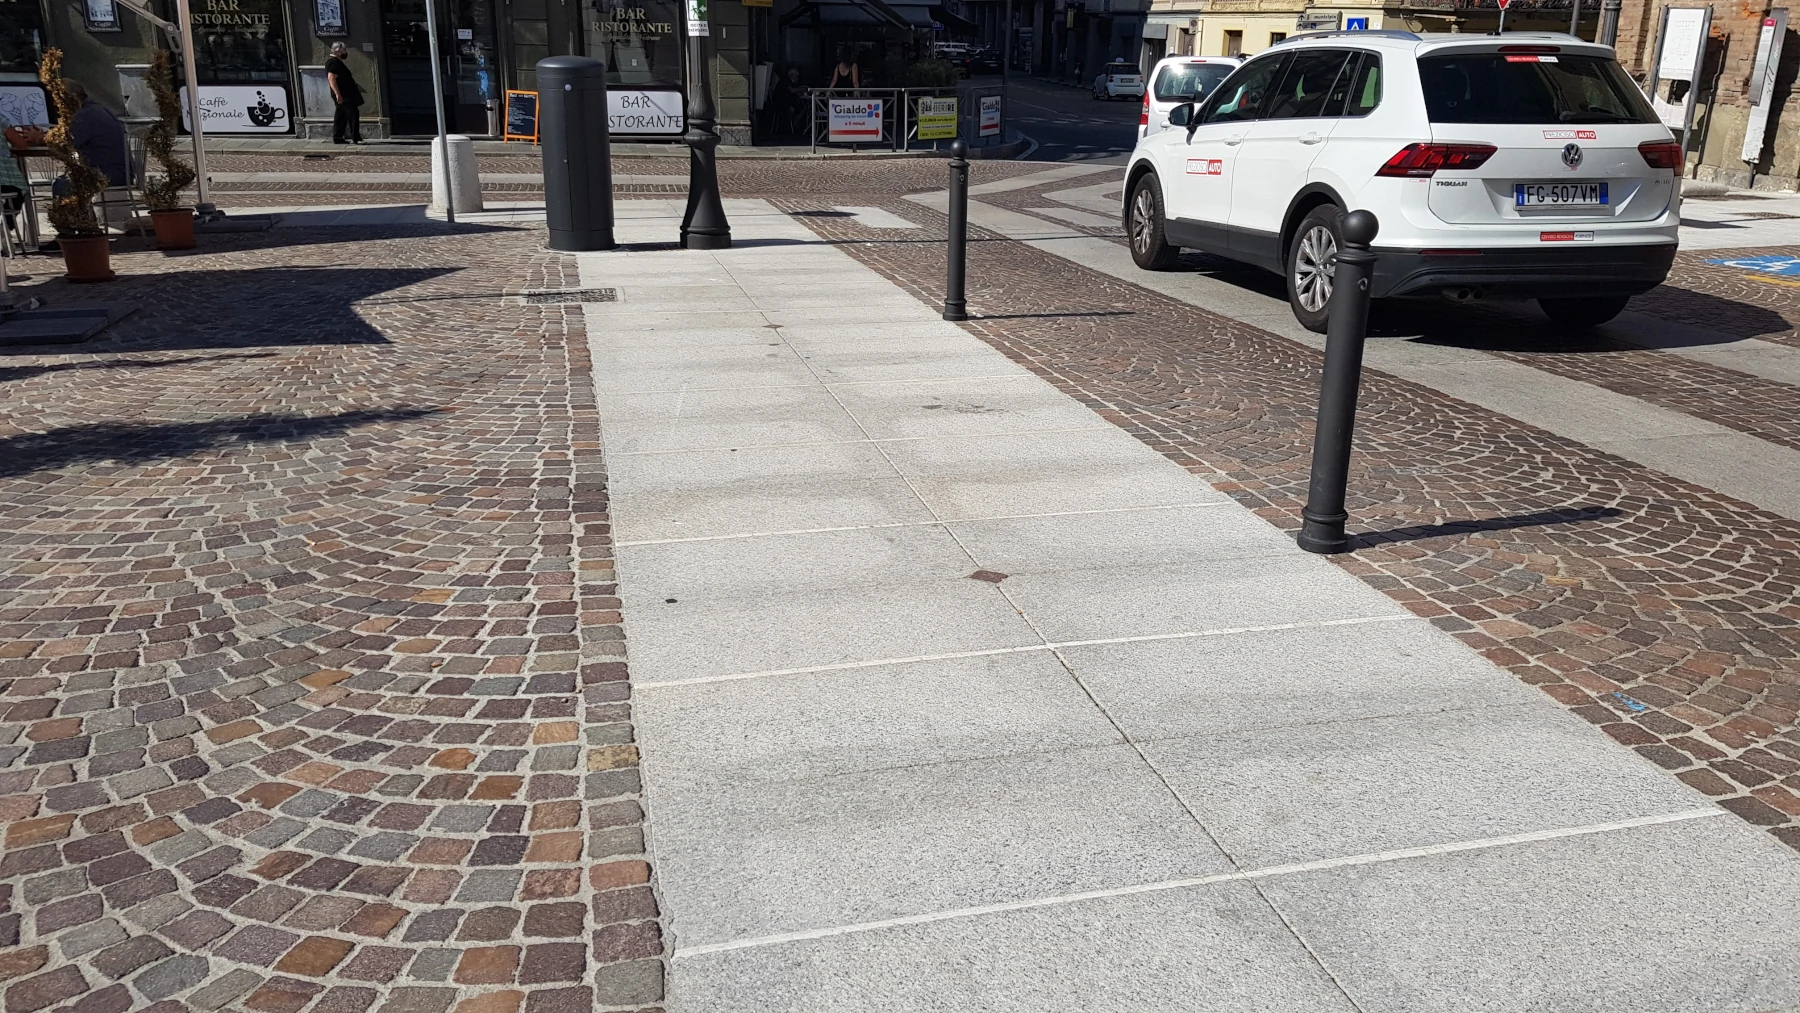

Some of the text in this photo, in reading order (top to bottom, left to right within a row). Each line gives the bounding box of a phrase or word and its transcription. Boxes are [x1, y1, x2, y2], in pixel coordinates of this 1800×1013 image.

[206, 0, 241, 11] BAR
[190, 13, 271, 25] ISTORANTE
[616, 7, 646, 20] BAR
[592, 21, 672, 34] RISTORANTE
[199, 96, 229, 108] Caffè
[620, 95, 651, 109] BAR
[186, 108, 245, 121] Nzionale
[834, 104, 867, 115] Gialdo
[607, 114, 683, 129] STORANTE
[1578, 131, 1596, 139] AUTO
[1208, 162, 1222, 173] AUTO
